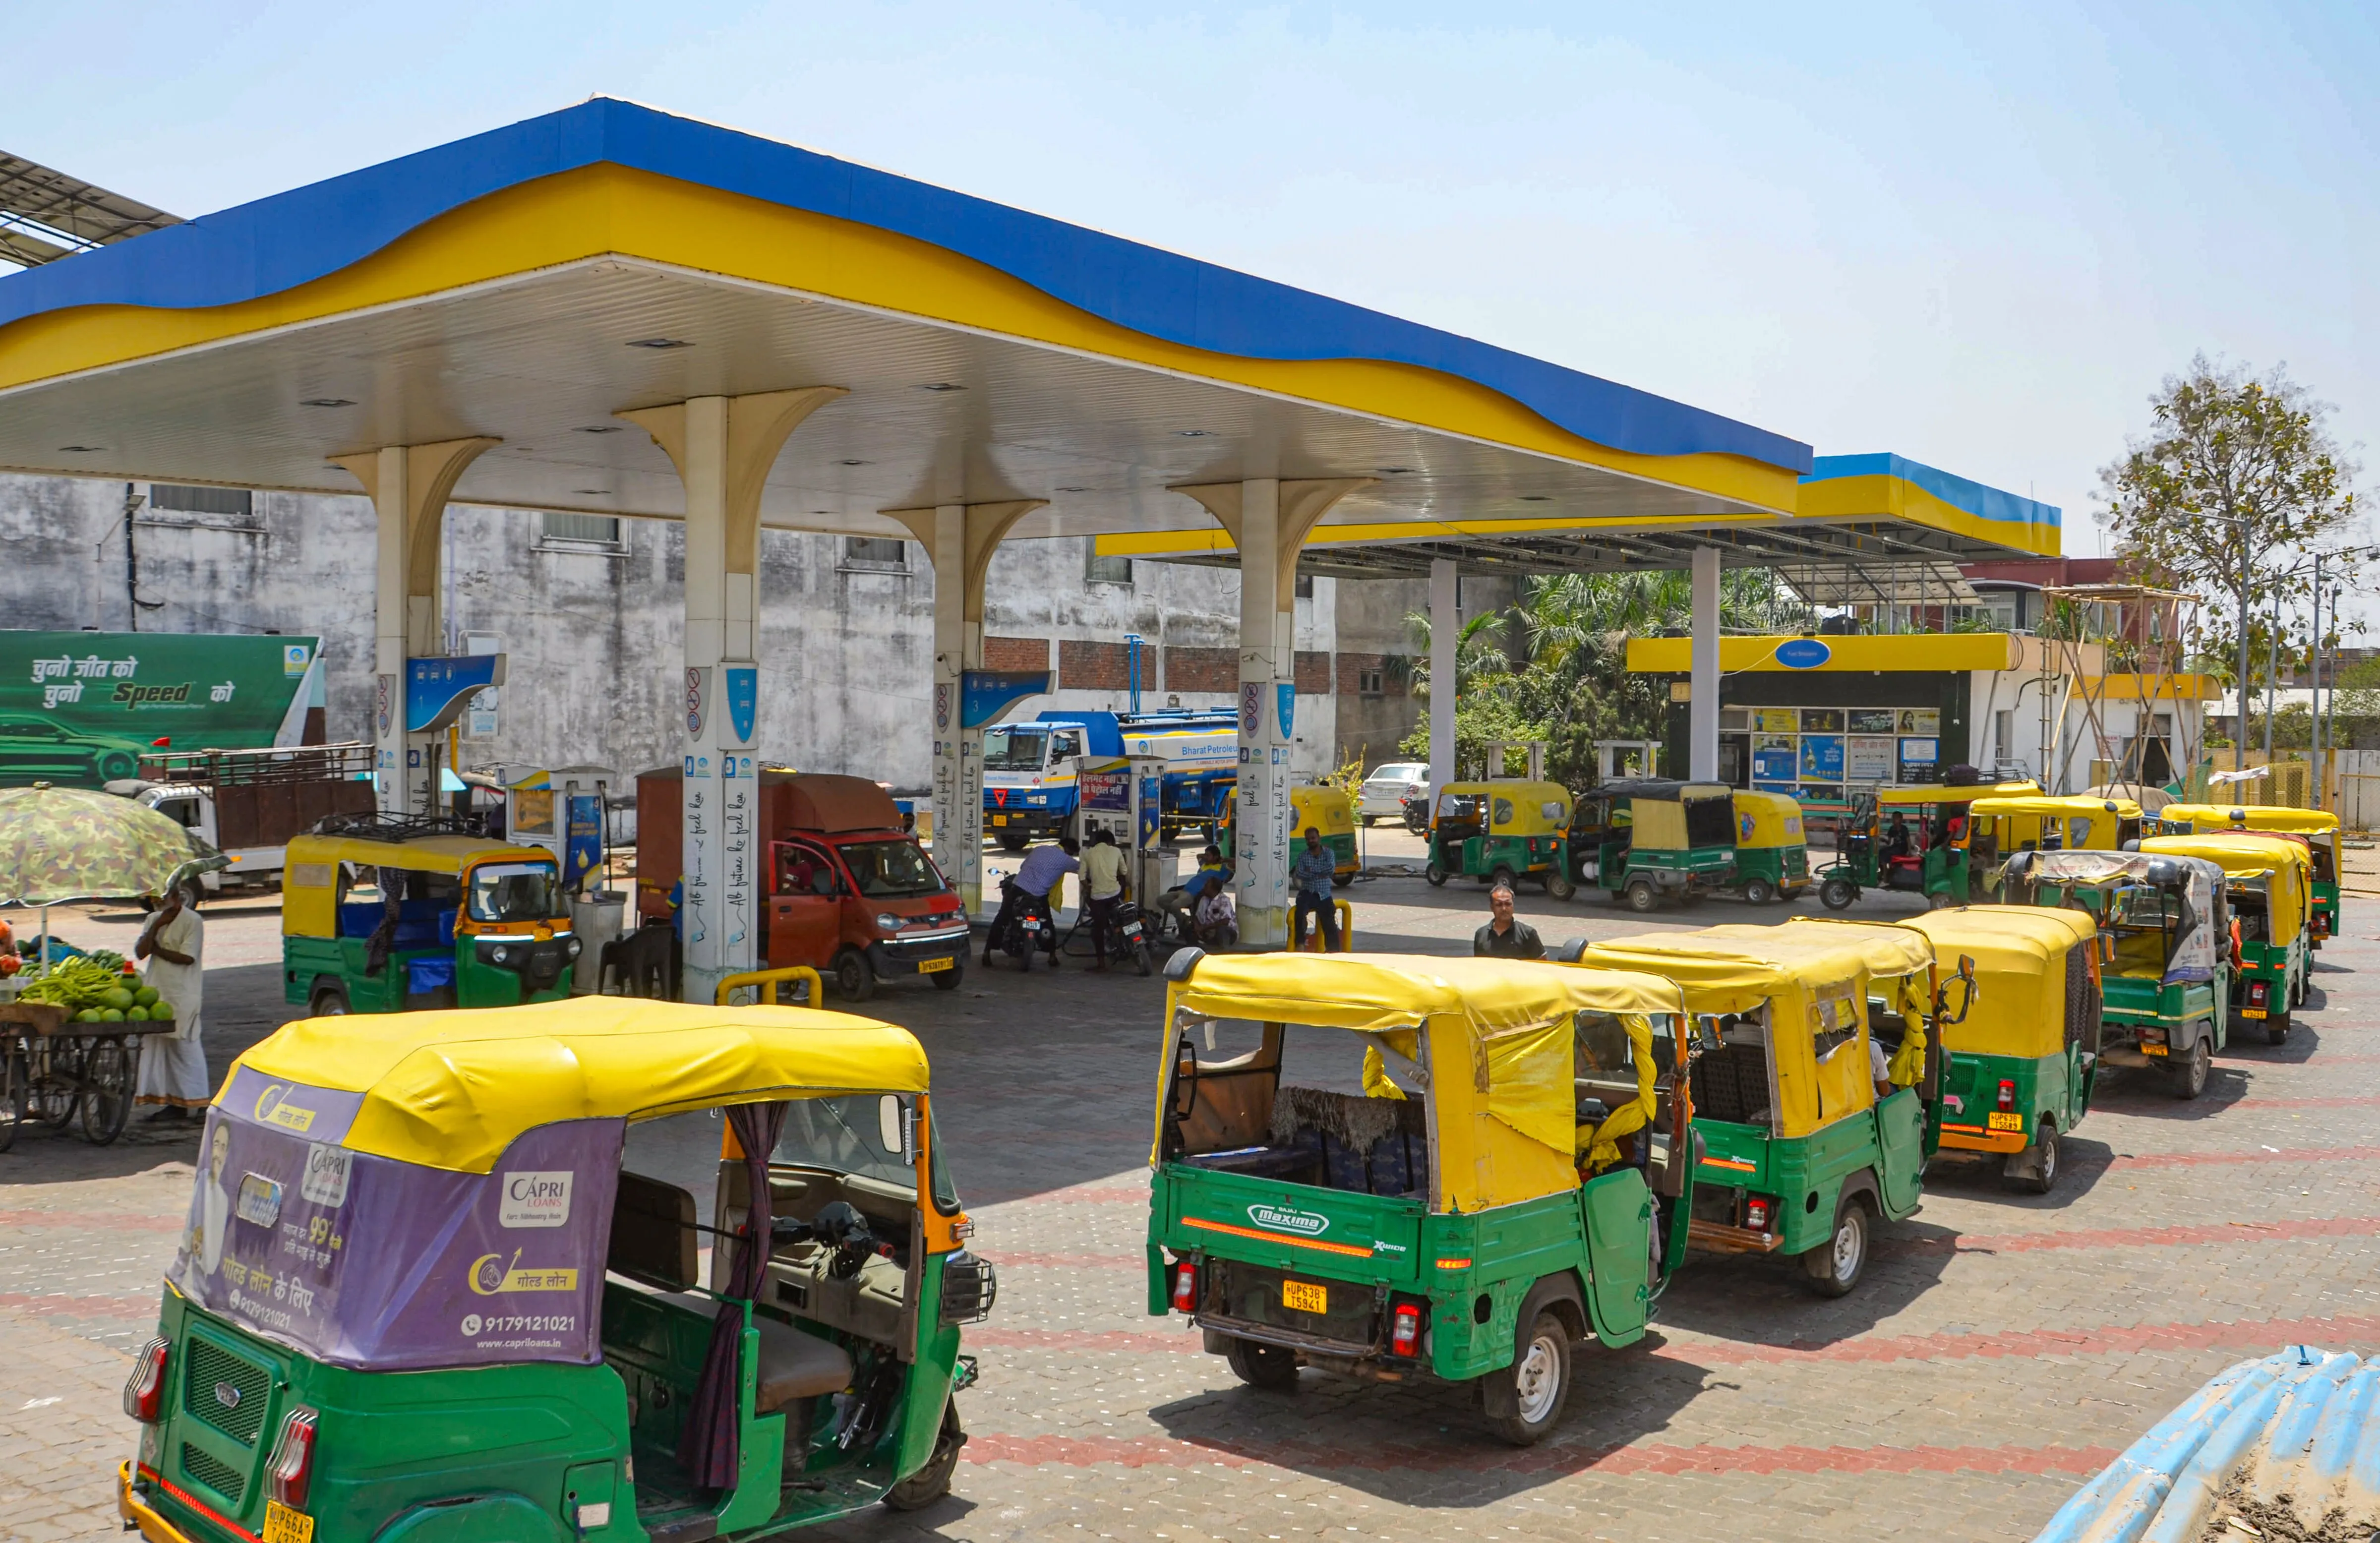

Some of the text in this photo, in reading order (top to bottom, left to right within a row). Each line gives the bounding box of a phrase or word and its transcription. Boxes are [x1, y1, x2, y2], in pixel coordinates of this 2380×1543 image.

[30, 654, 138, 682] चुनो जीत को
[43, 680, 236, 711] चुनो Speed को
[973, 700, 979, 712] 3
[1182, 744, 1238, 755] Bharat Petroleu
[1242, 790, 1259, 807] feel
[1274, 791, 1286, 807] feel
[727, 814, 750, 835] feel
[727, 891, 746, 906] Ab
[278, 1107, 307, 1127] गोल्ड लोन
[311, 1148, 345, 1175] CAPRI
[510, 1176, 564, 1200] CAPRI
[528, 1198, 561, 1207] LOANS
[223, 1251, 314, 1317] गोल्ड लोन के लिए
[517, 1271, 569, 1288] गोल्ड लोन
[1291, 1283, 1320, 1299] UP63B
[1291, 1296, 1319, 1311] T5941
[239, 1297, 291, 1329] 9179121021
[485, 1316, 576, 1332] 9179121021
[477, 1337, 562, 1349] www.capriloans.in
[275, 1508, 303, 1536] UP66A
